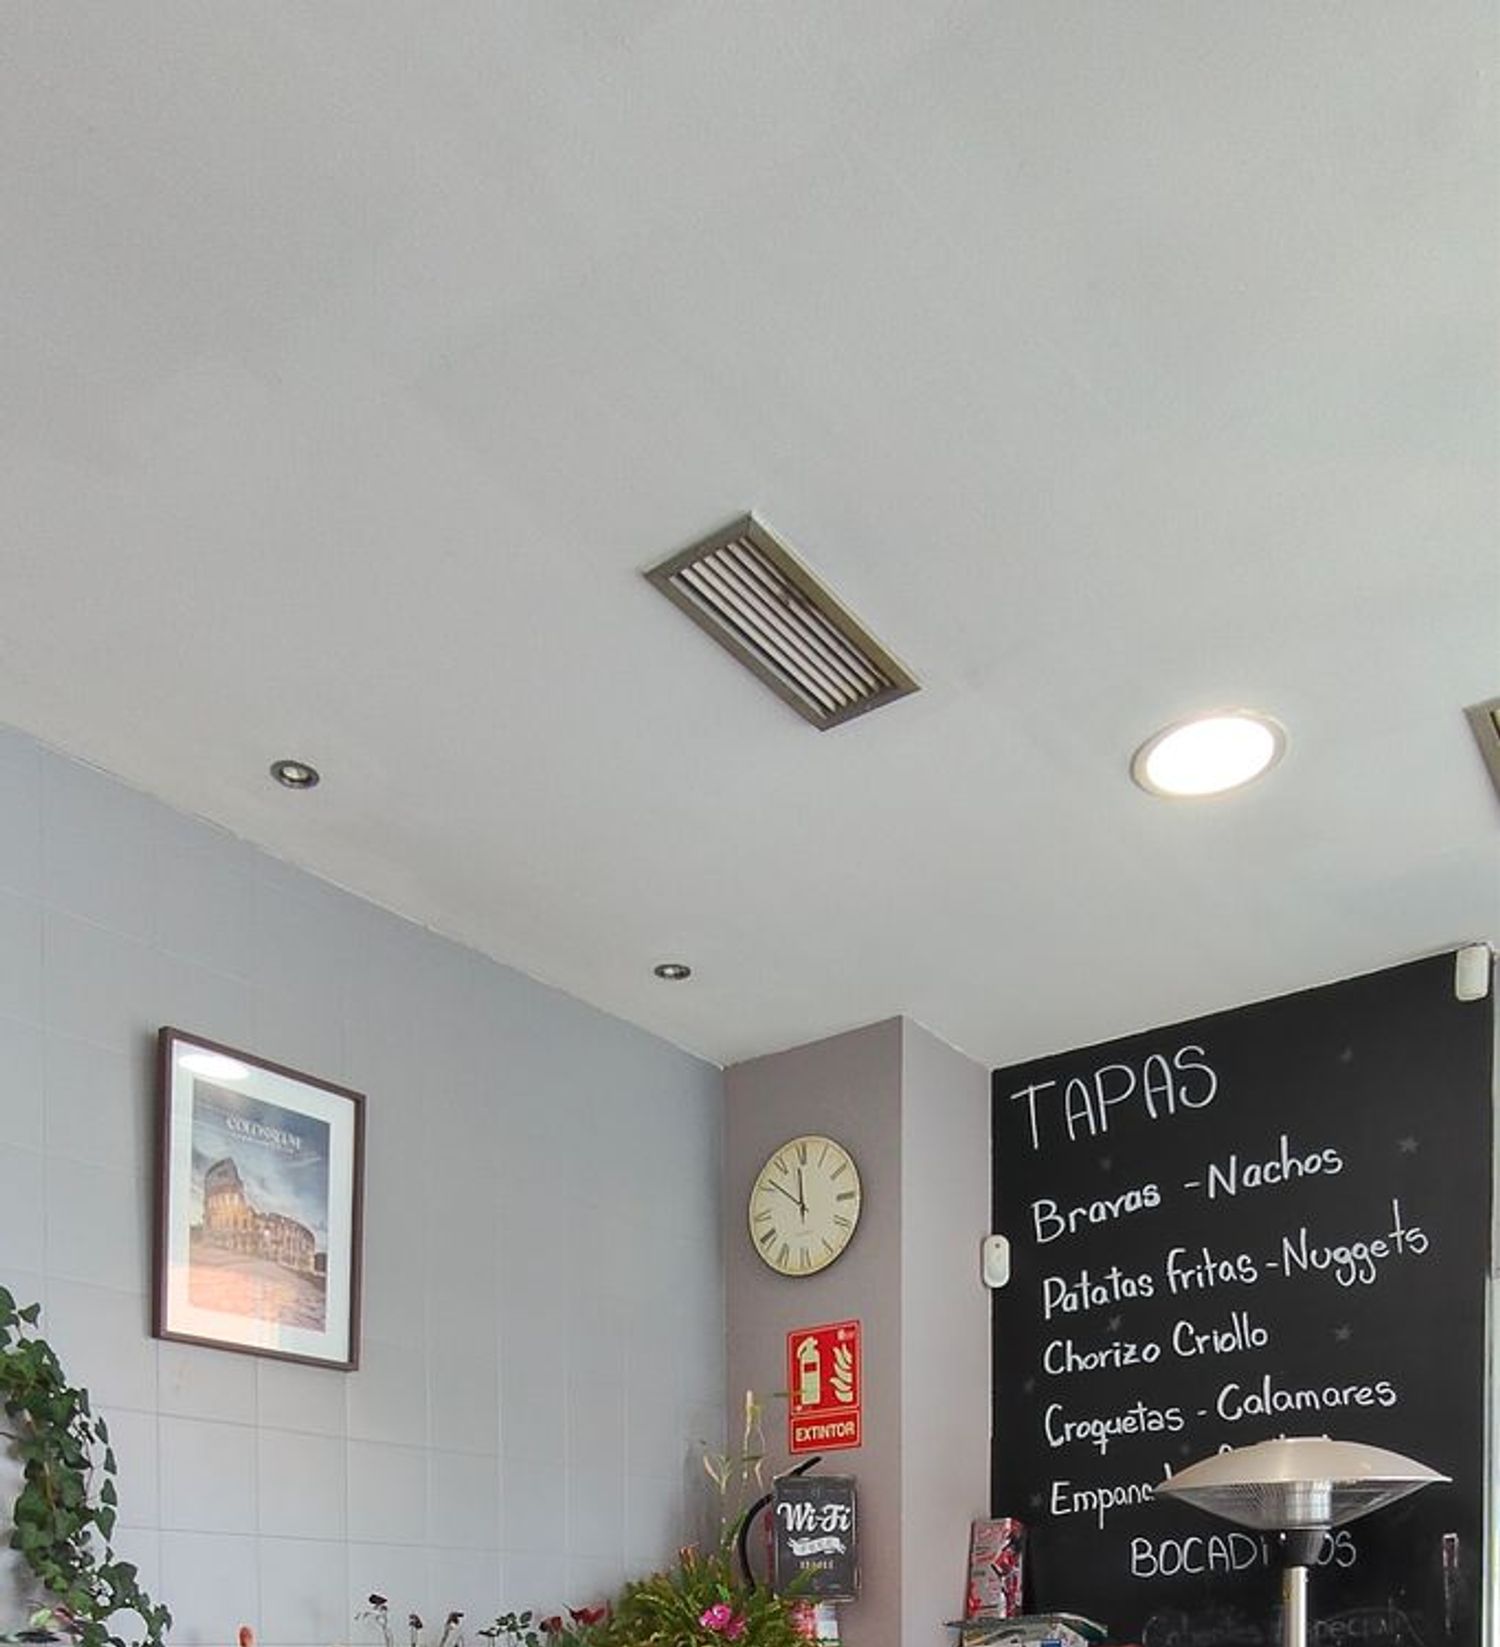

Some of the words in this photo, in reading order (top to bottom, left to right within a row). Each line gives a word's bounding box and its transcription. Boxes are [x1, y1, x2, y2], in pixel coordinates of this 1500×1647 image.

[1010, 1045, 1218, 1150] TAPAS
[1031, 1183, 1162, 1244] Bravas
[1043, 1266, 1154, 1320] Patatas
[1043, 1339, 1161, 1375] Chorizo
[1172, 1311, 1269, 1357] Criollo
[795, 1420, 855, 1442] EXTINTOR
[1044, 1401, 1185, 1455] Croquetas
[1216, 1374, 1397, 1422] Calamares
[776, 1501, 851, 1532] Wi-Fi
